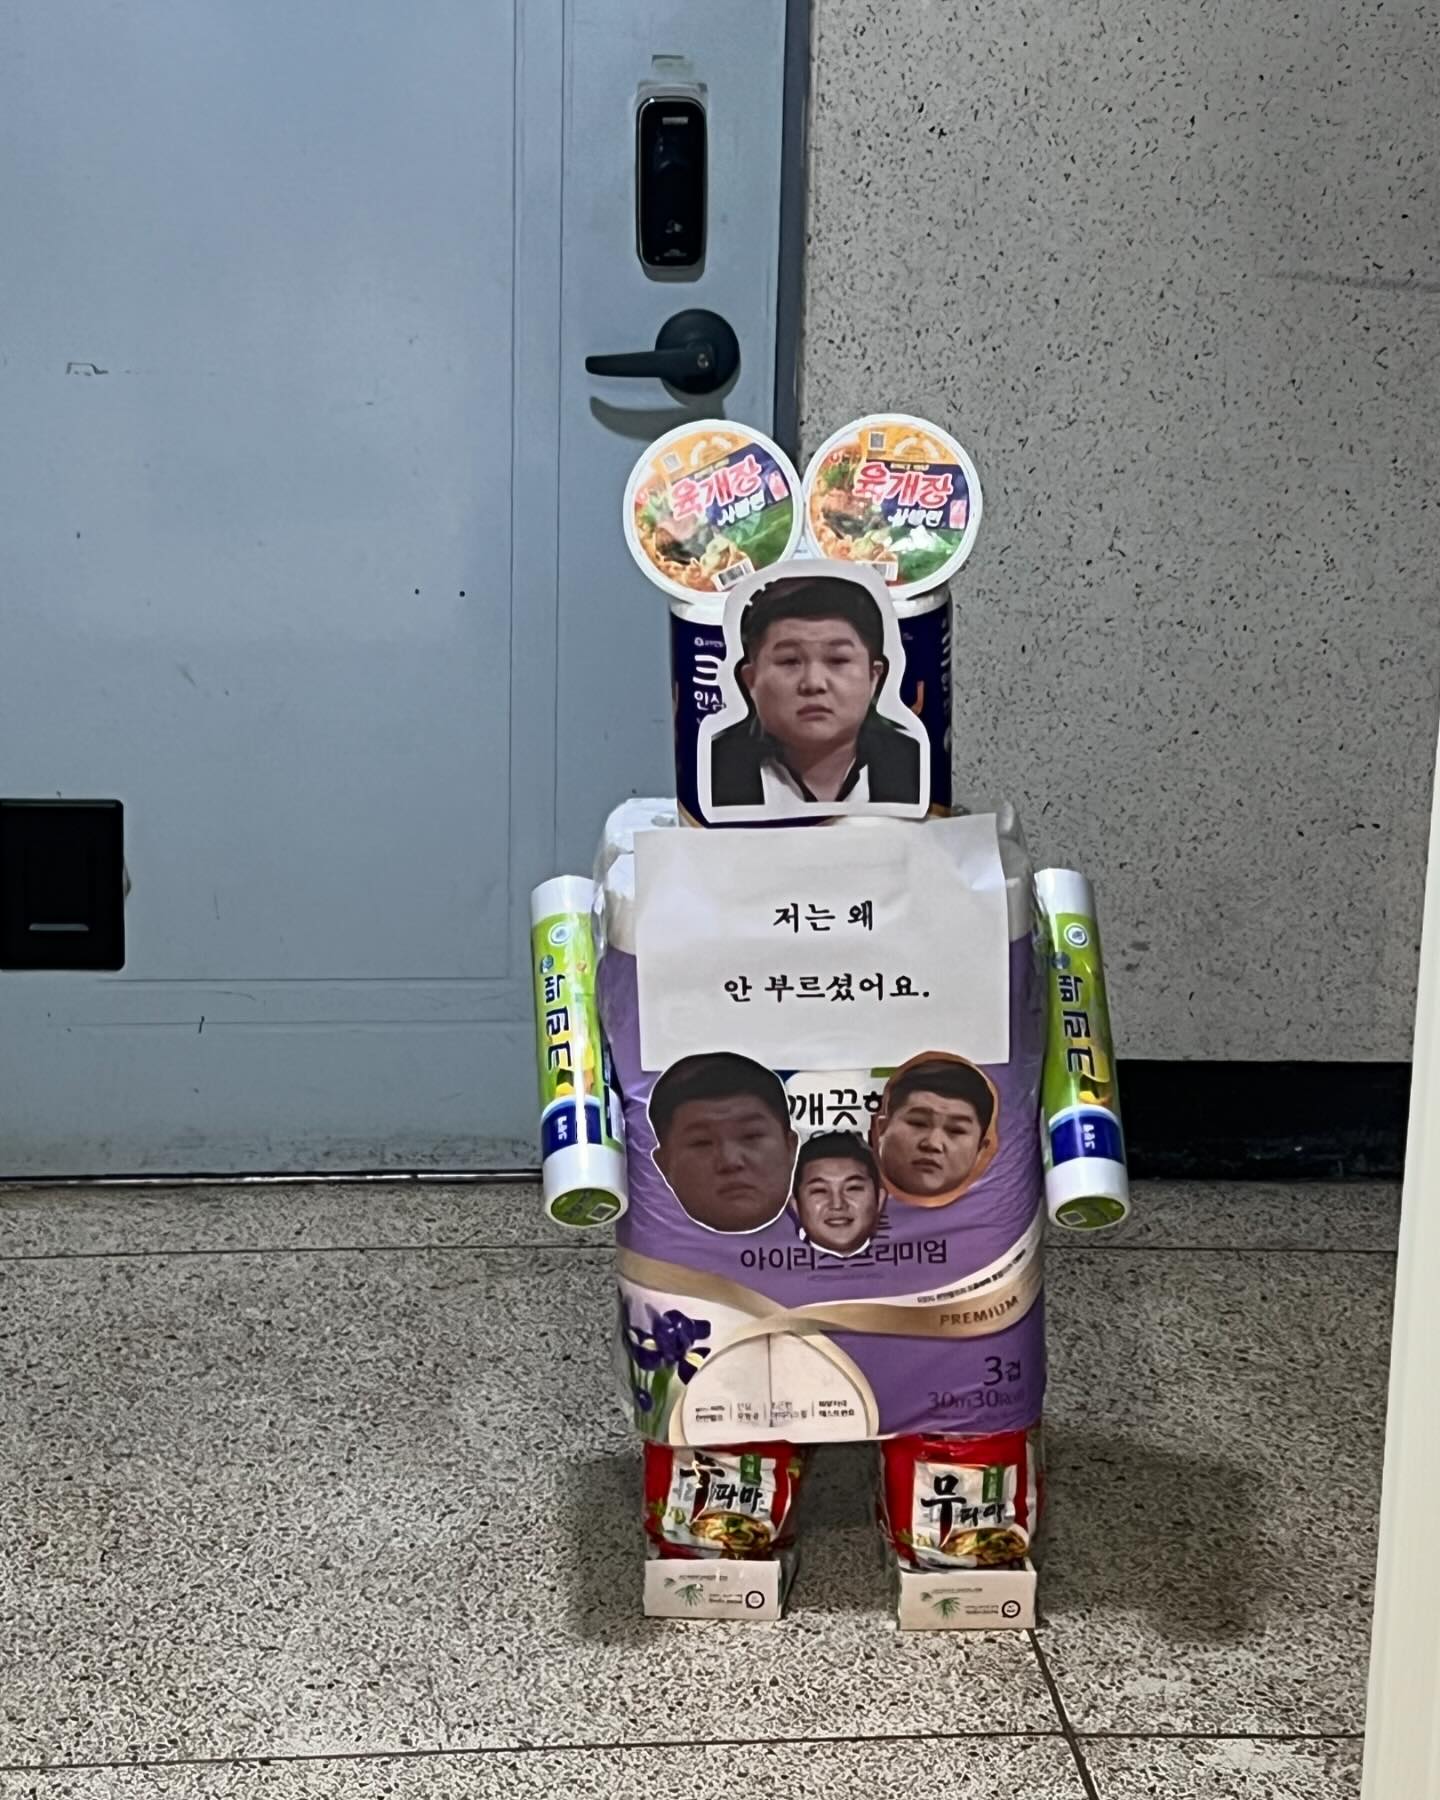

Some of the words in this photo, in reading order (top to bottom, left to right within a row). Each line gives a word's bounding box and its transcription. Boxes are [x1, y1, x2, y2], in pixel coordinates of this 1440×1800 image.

[672, 454, 762, 520] 육개장
[852, 462, 954, 511] 육개장
[773, 902, 836, 933] 저는
[847, 900, 874, 931] 왜
[724, 976, 752, 1002] 안
[764, 973, 930, 1002] 부르셨어요.
[543, 974, 573, 1073] 크린백
[1058, 975, 1095, 1076] 크린백
[940, 1295, 1019, 1327] PREMIUM
